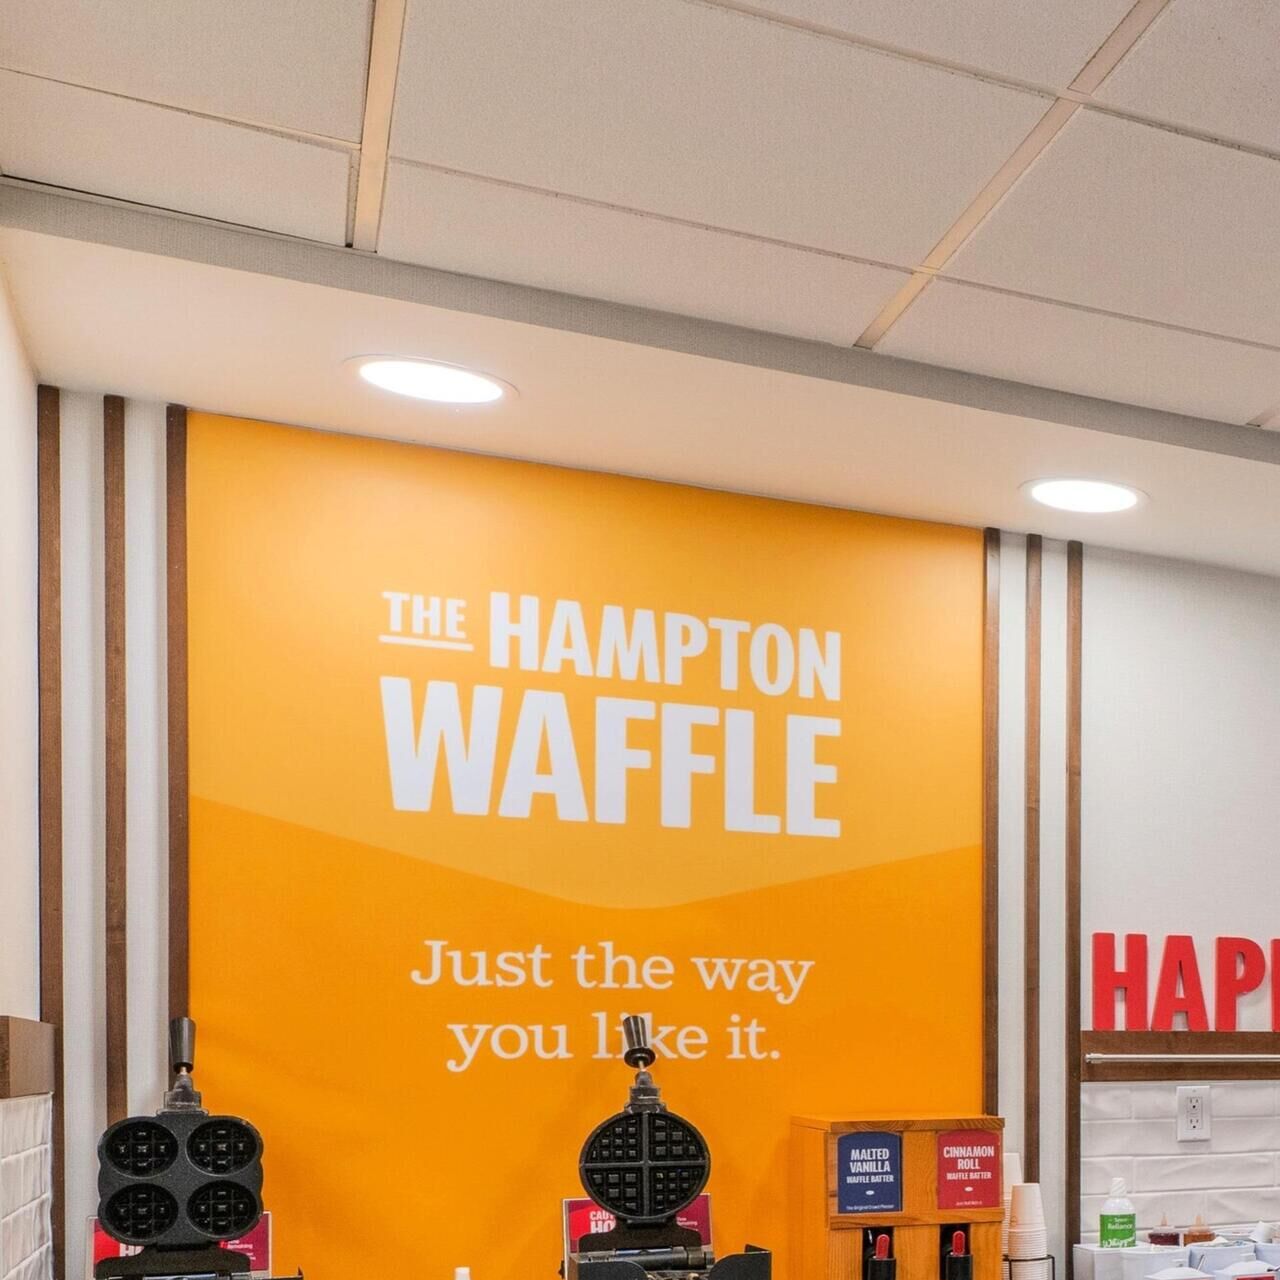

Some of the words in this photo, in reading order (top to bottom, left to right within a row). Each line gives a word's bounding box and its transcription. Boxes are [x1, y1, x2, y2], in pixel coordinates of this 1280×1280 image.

[382, 591, 467, 639] THE
[489, 592, 841, 701] HAMPTON
[380, 676, 841, 838] WAFFLE
[410, 939, 553, 989] Just
[570, 940, 675, 990] the
[690, 956, 816, 1005] way
[446, 1022, 574, 1073] you
[725, 1013, 781, 1060] it.
[851, 1148, 889, 1161] MALTED
[943, 1146, 994, 1158] CINNAMON
[849, 1161, 891, 1173] VANILLA
[957, 1158, 980, 1170] ROLL
[846, 1176, 870, 1184] WAFFLE
[871, 1175, 894, 1183] BATTER
[946, 1173, 968, 1181] WAFFLE
[969, 1172, 992, 1180] BATTER
